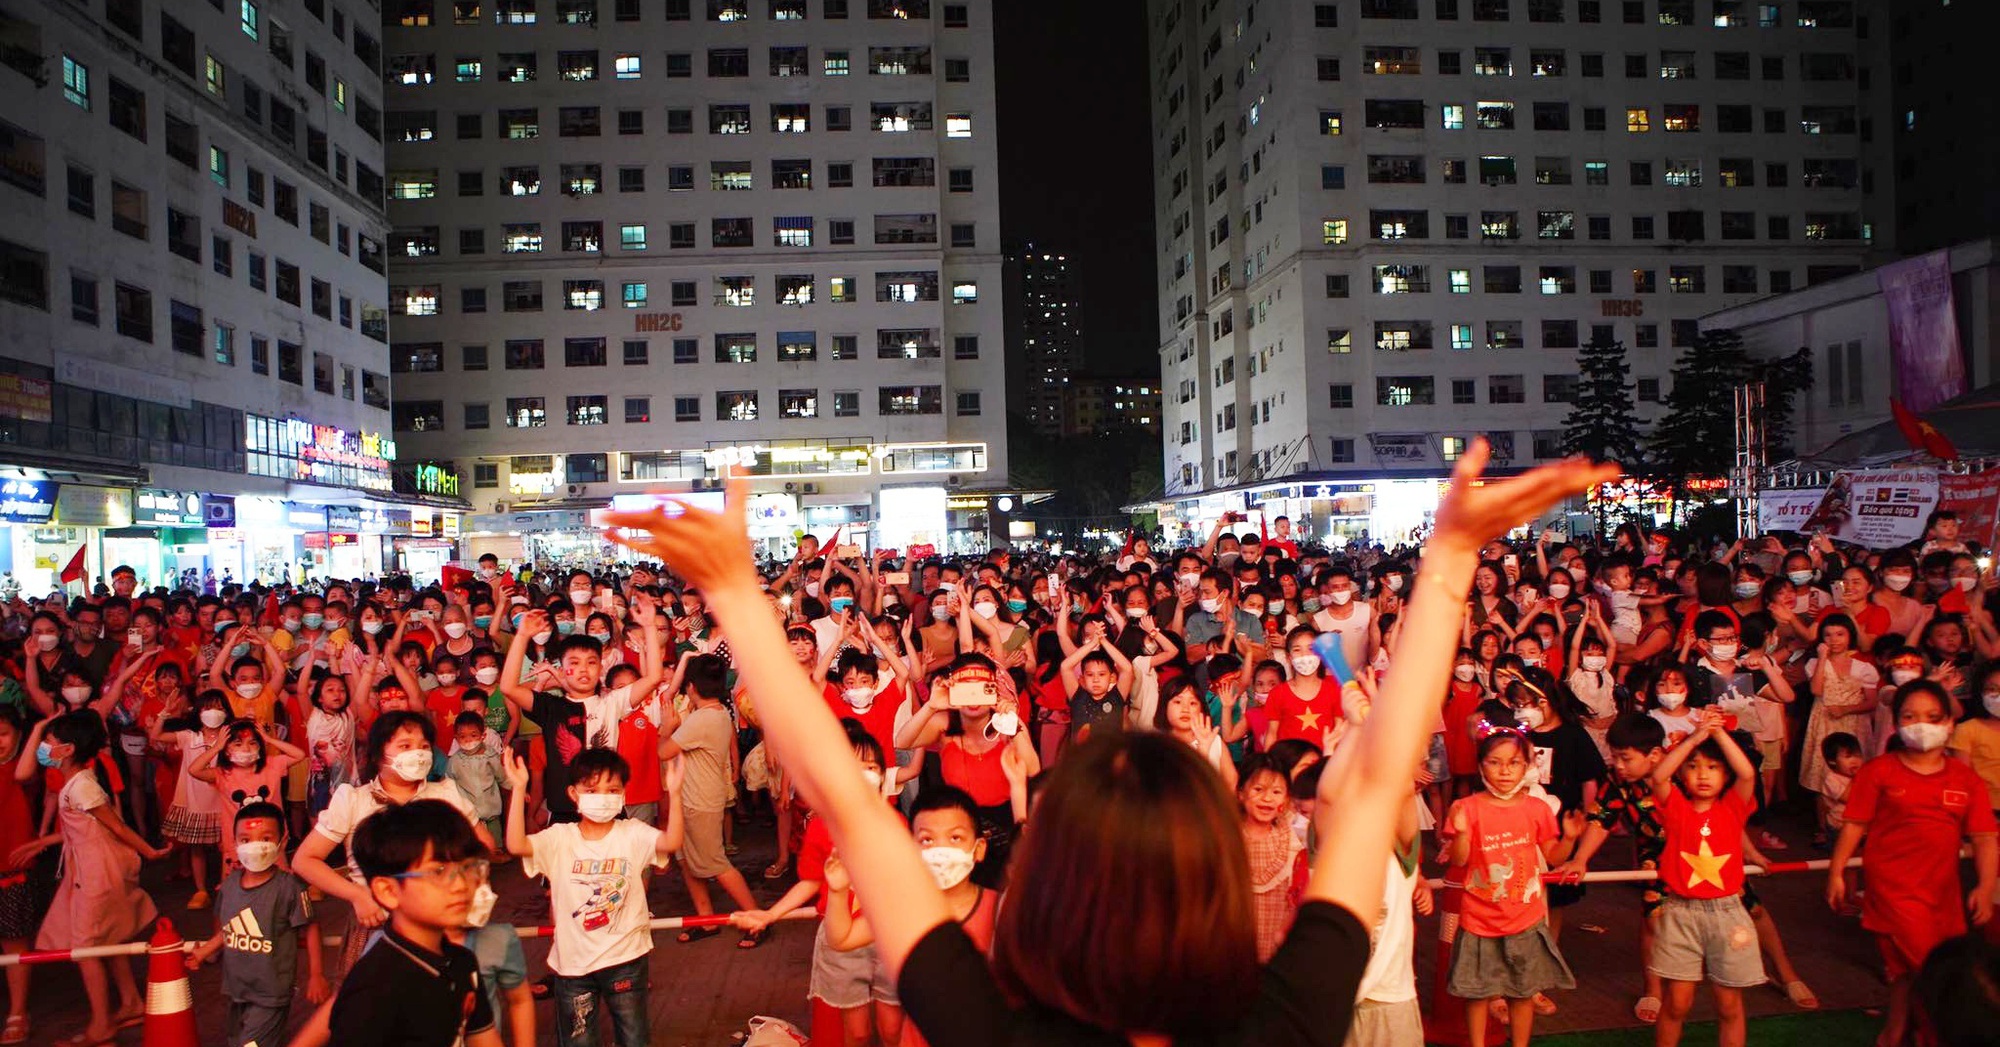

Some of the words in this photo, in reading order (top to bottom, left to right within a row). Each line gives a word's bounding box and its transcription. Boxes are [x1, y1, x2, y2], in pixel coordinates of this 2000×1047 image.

[222, 197, 257, 239] HH2A
[1601, 299, 1643, 317] HH3C
[635, 313, 682, 332] HH2C
[286, 418, 313, 445] KHU
[380, 438, 397, 461] EM
[437, 467, 459, 496] Mart
[1778, 500, 1790, 515] TỔ
[1790, 505, 1798, 515] Y
[1800, 500, 1814, 515] TẾ
[224, 931, 273, 953] didas
